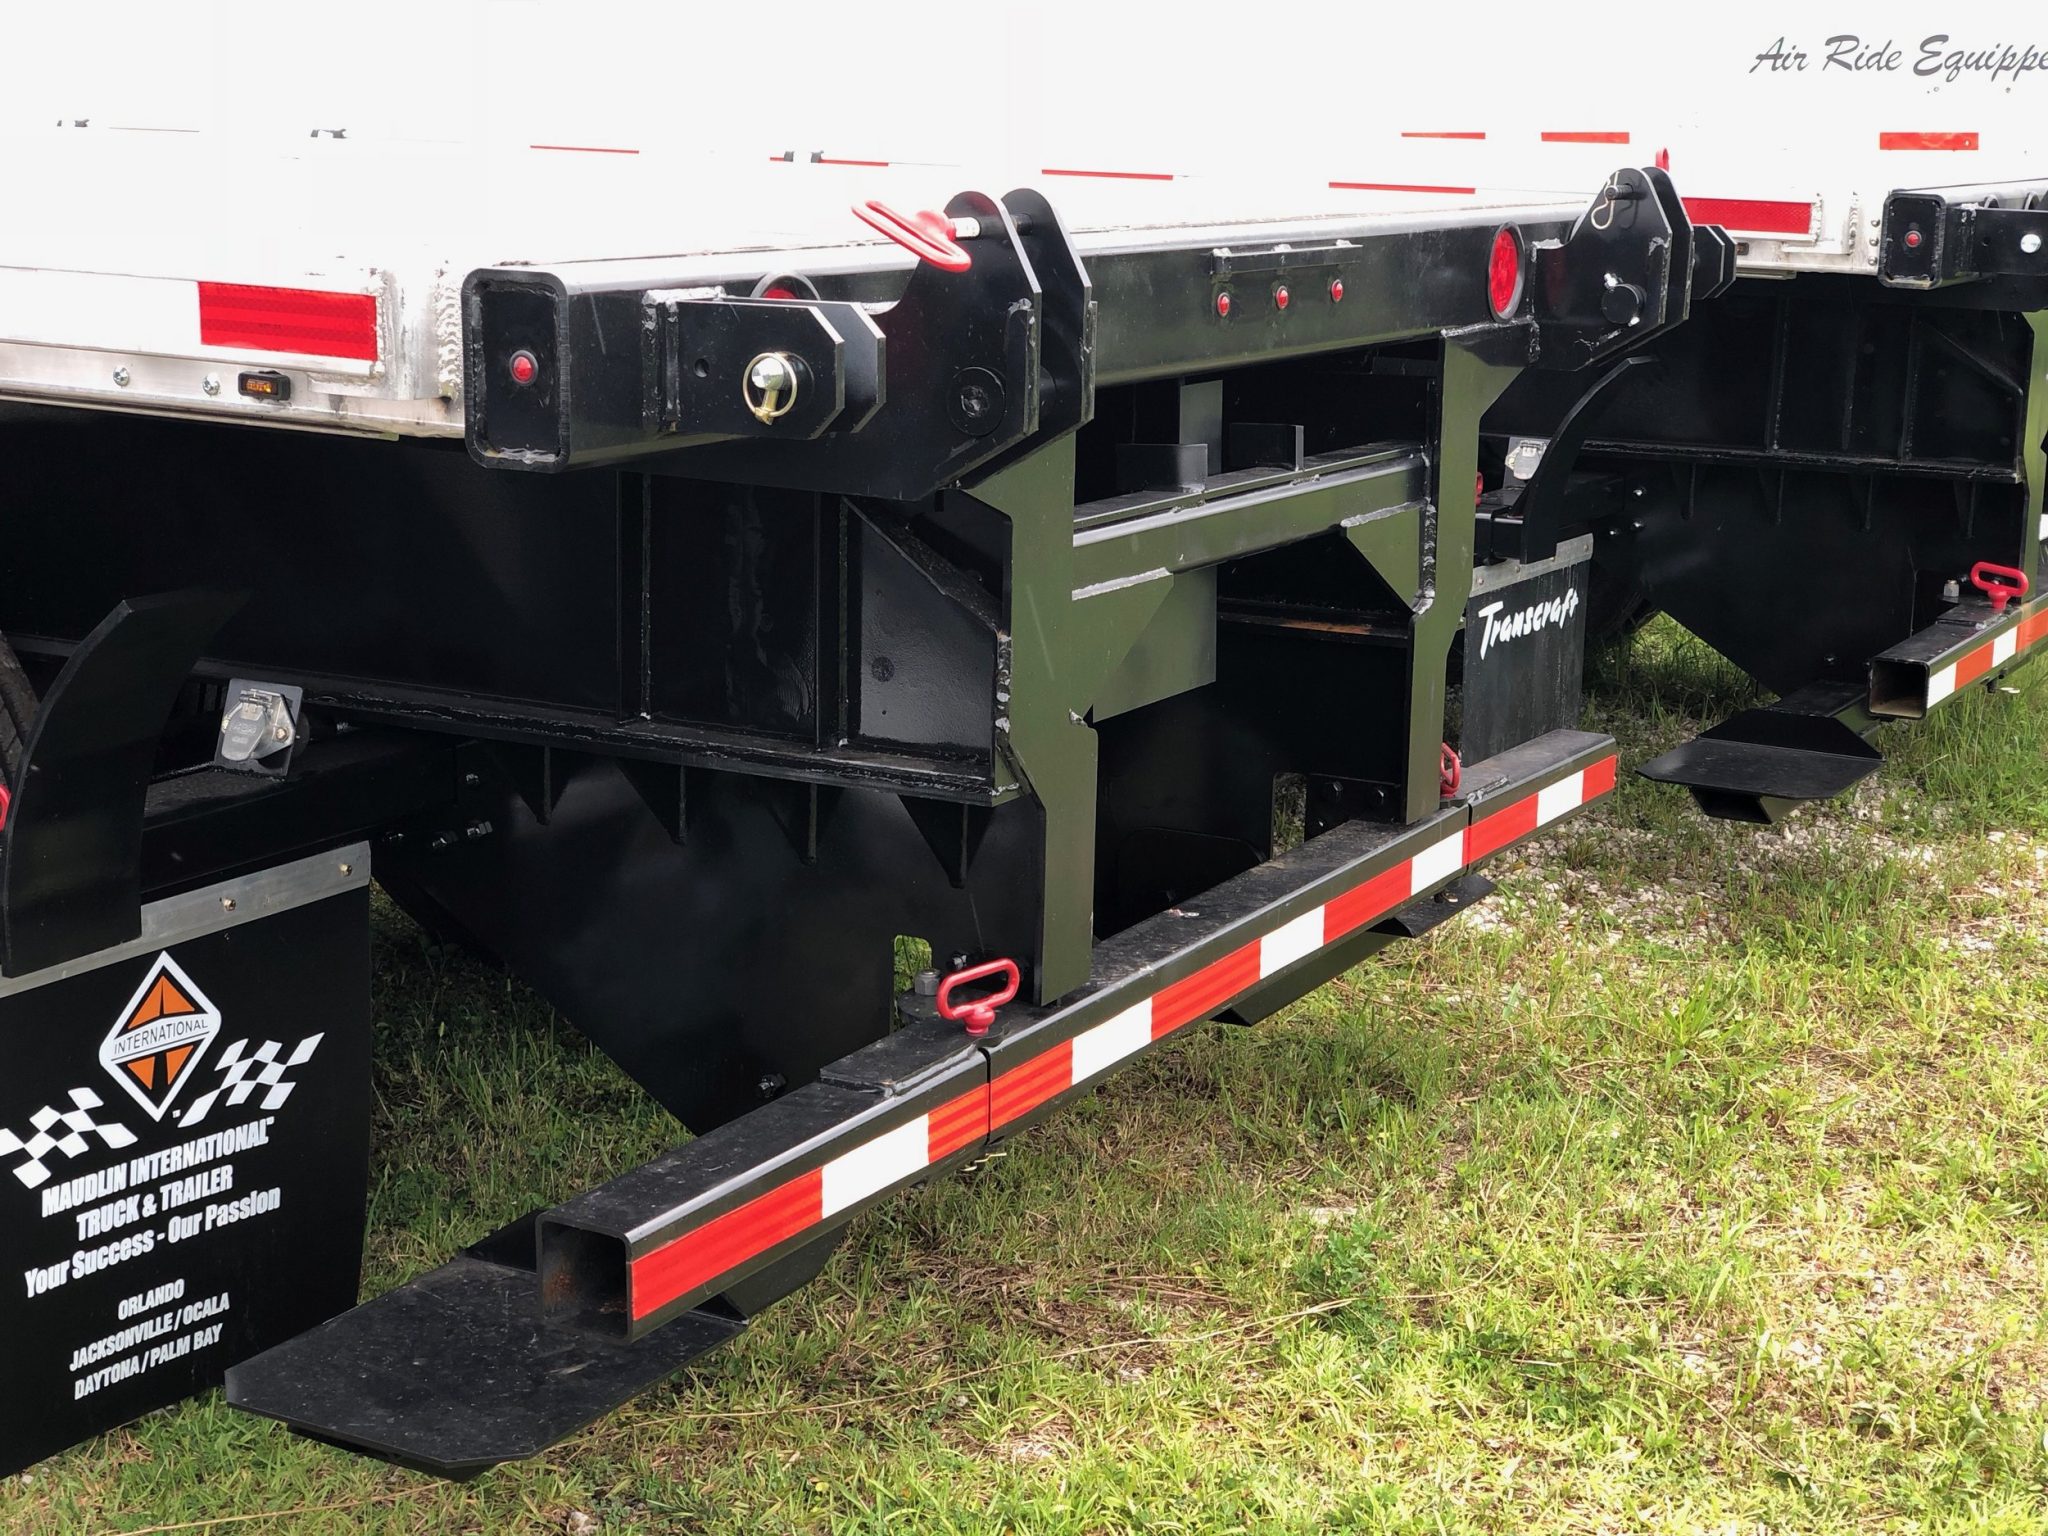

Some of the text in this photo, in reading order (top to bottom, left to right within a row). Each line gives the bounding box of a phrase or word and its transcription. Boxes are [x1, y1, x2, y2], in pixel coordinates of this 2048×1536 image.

[1749, 36, 1809, 74] Air
[1822, 34, 1903, 72] Ride
[1478, 588, 1579, 660] Transcraft
[114, 1019, 208, 1055] INTERNATIONAL
[42, 1162, 127, 1218] MAUDLIN
[76, 1164, 233, 1241] TRUCK & TRAILER
[24, 1260, 71, 1298] Your
[71, 1229, 154, 1279] Success
[168, 1213, 202, 1243] Our
[204, 1187, 281, 1231] Passion
[118, 1278, 185, 1320] ORLANDO
[193, 1323, 223, 1351] BAY
